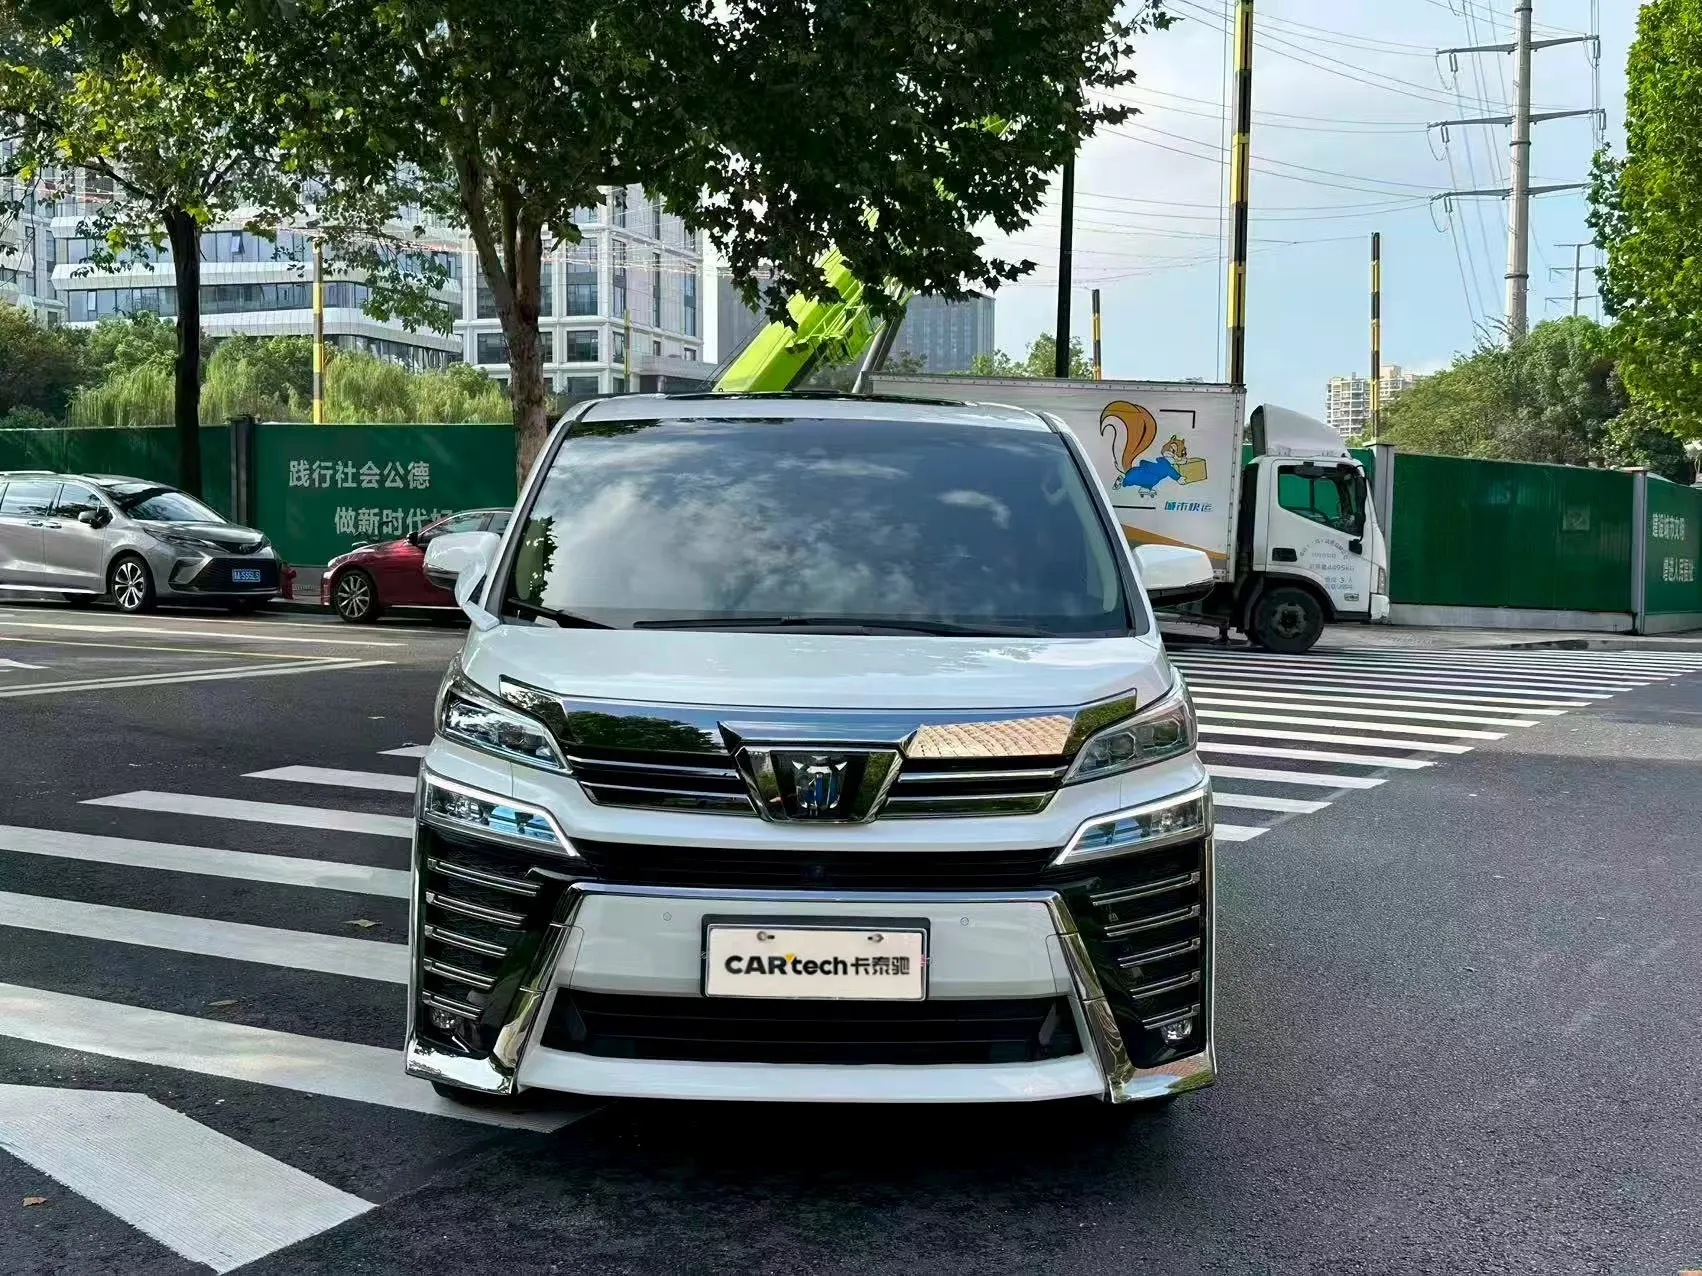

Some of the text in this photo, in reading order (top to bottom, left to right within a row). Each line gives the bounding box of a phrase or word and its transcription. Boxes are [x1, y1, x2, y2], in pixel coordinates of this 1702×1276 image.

[289, 460, 430, 489] 践行社会公德
[725, 954, 909, 976] CARtech 卡泰驰
